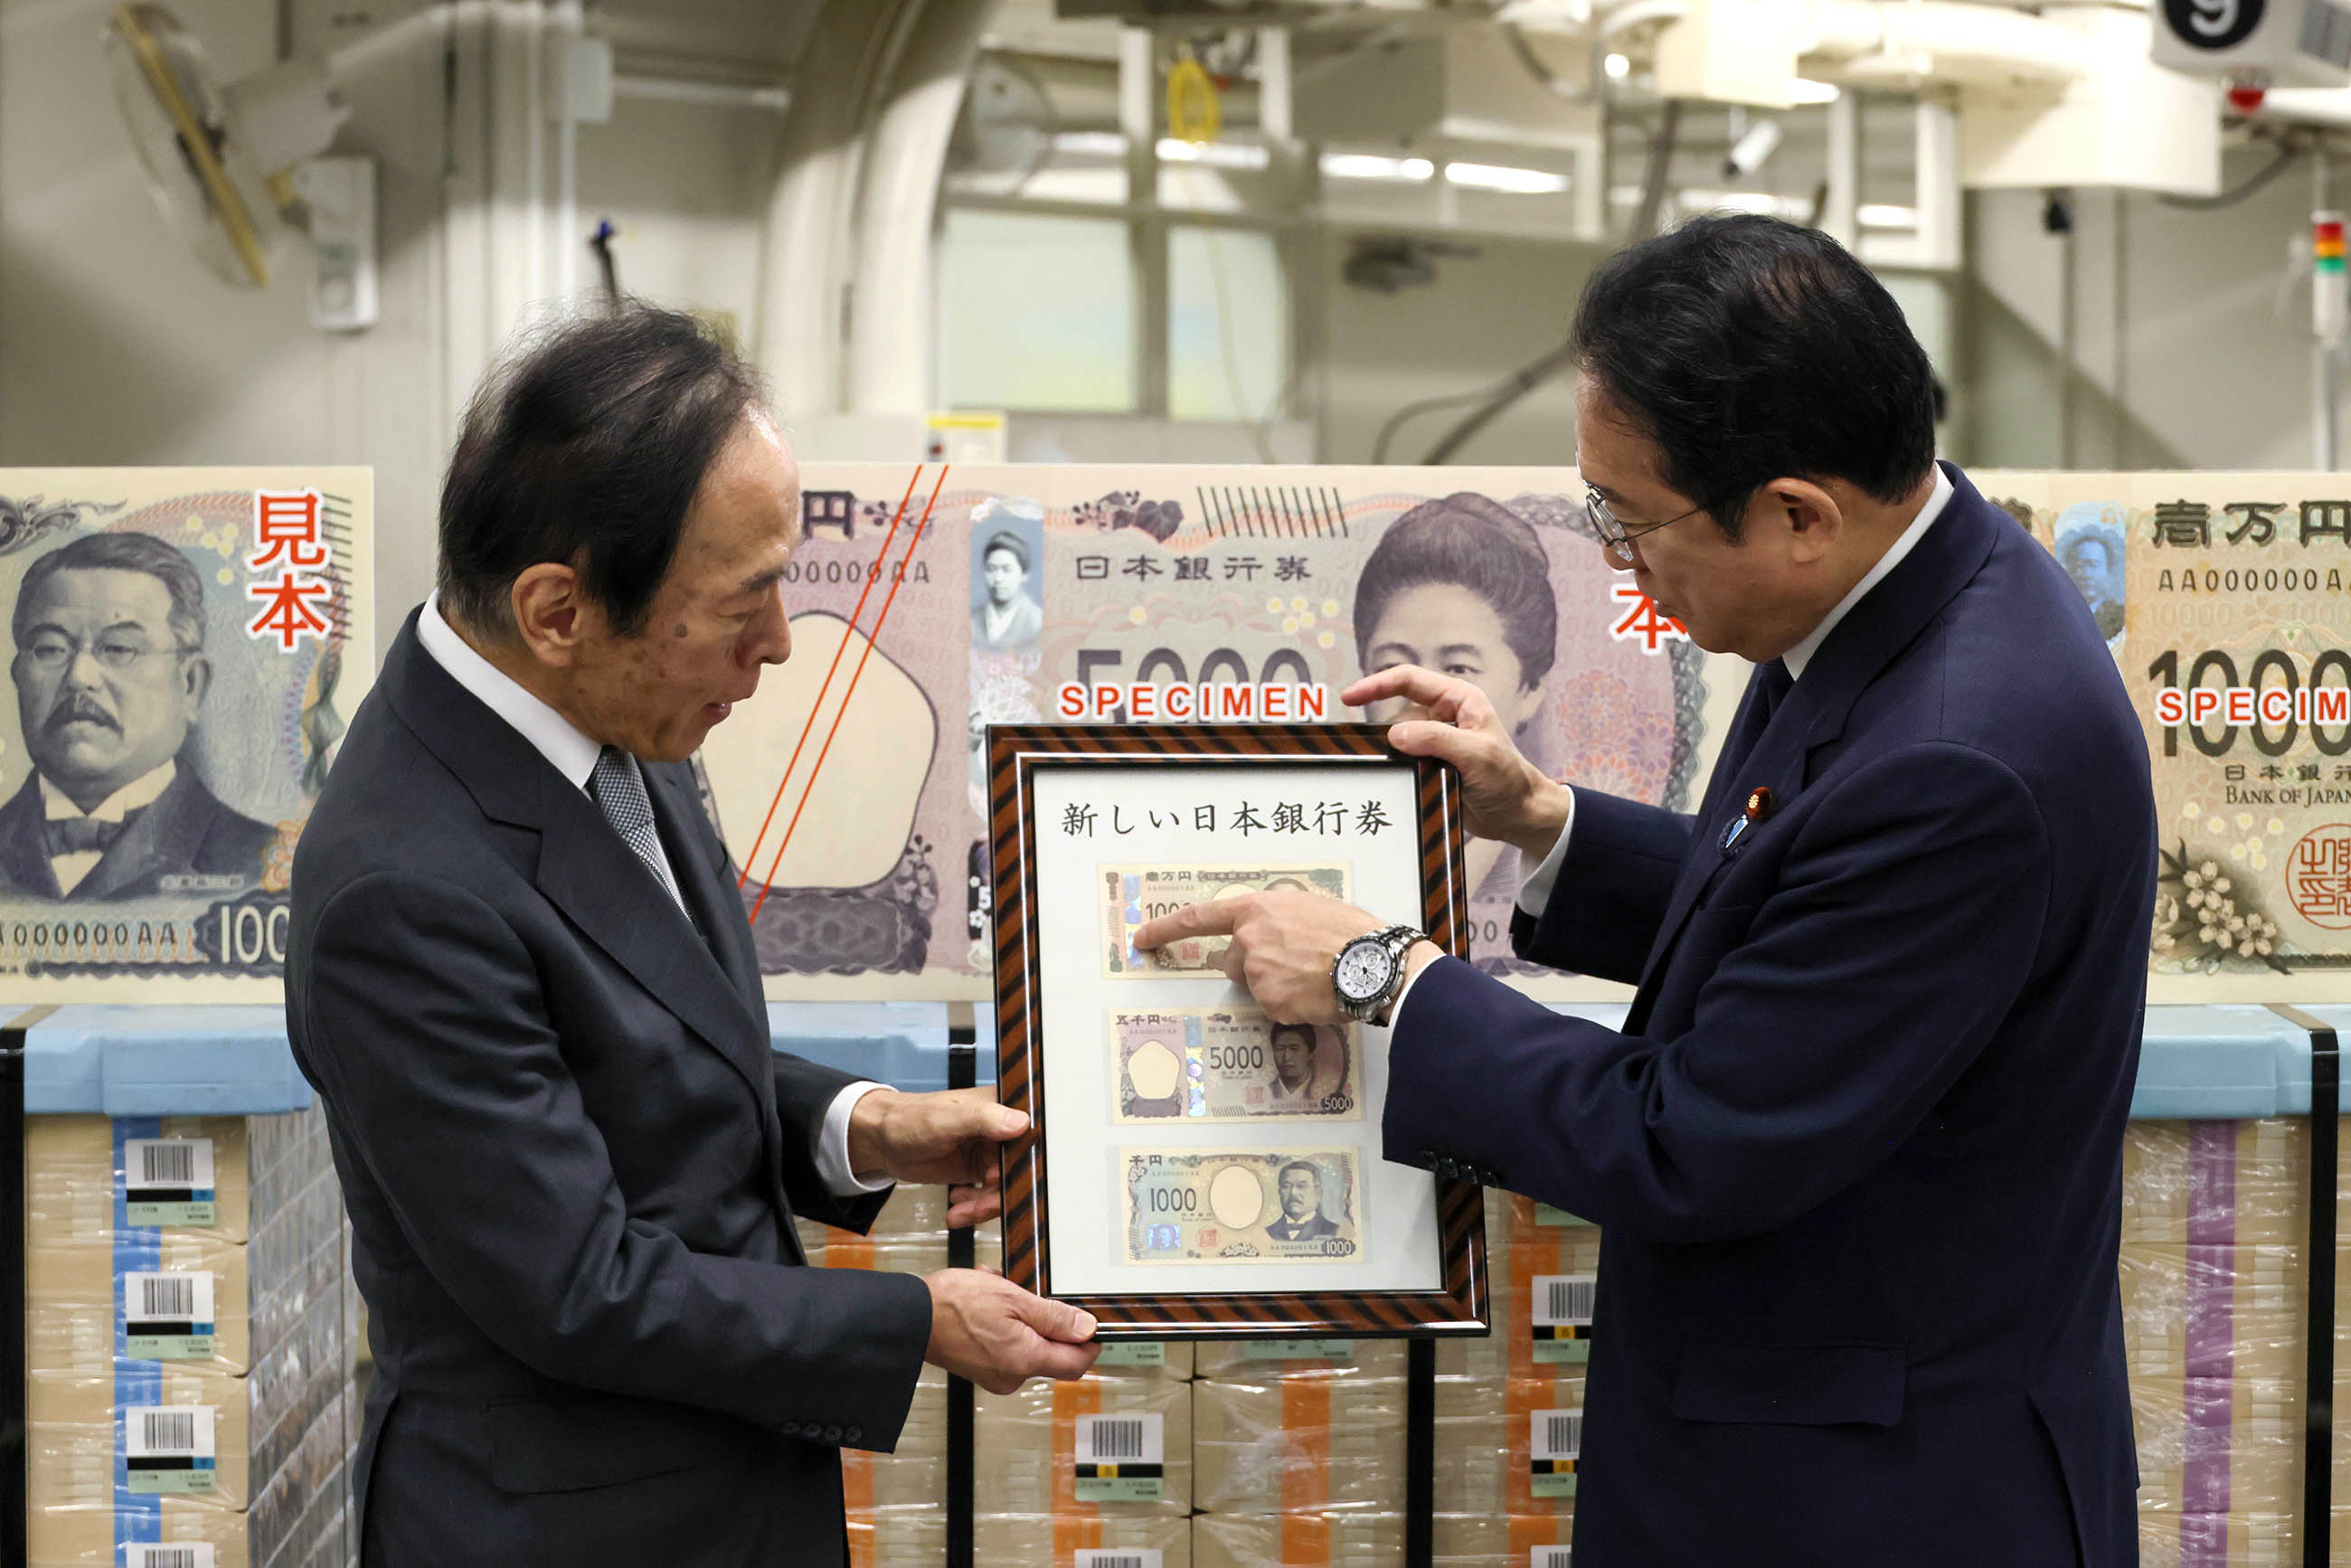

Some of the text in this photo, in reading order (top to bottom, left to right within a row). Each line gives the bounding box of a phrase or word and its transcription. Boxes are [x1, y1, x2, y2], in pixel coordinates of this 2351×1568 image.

[801, 490, 855, 540] 円
[251, 493, 328, 647] 見本
[1075, 554, 1314, 581] 日本銀行券
[2158, 569, 2351, 591] AA000000A
[1061, 686, 1324, 717] SPECIMEN
[2159, 691, 2347, 722] SPECIM
[1061, 799, 1393, 838] 新しい日本銀行券
[0, 921, 176, 946] 000000AA
[221, 905, 290, 964] 100
[1209, 1045, 1263, 1070] 5000
[1323, 1097, 1351, 1110] 5000
[1149, 1187, 1197, 1213] 1000
[1326, 1241, 1351, 1254] 1000
